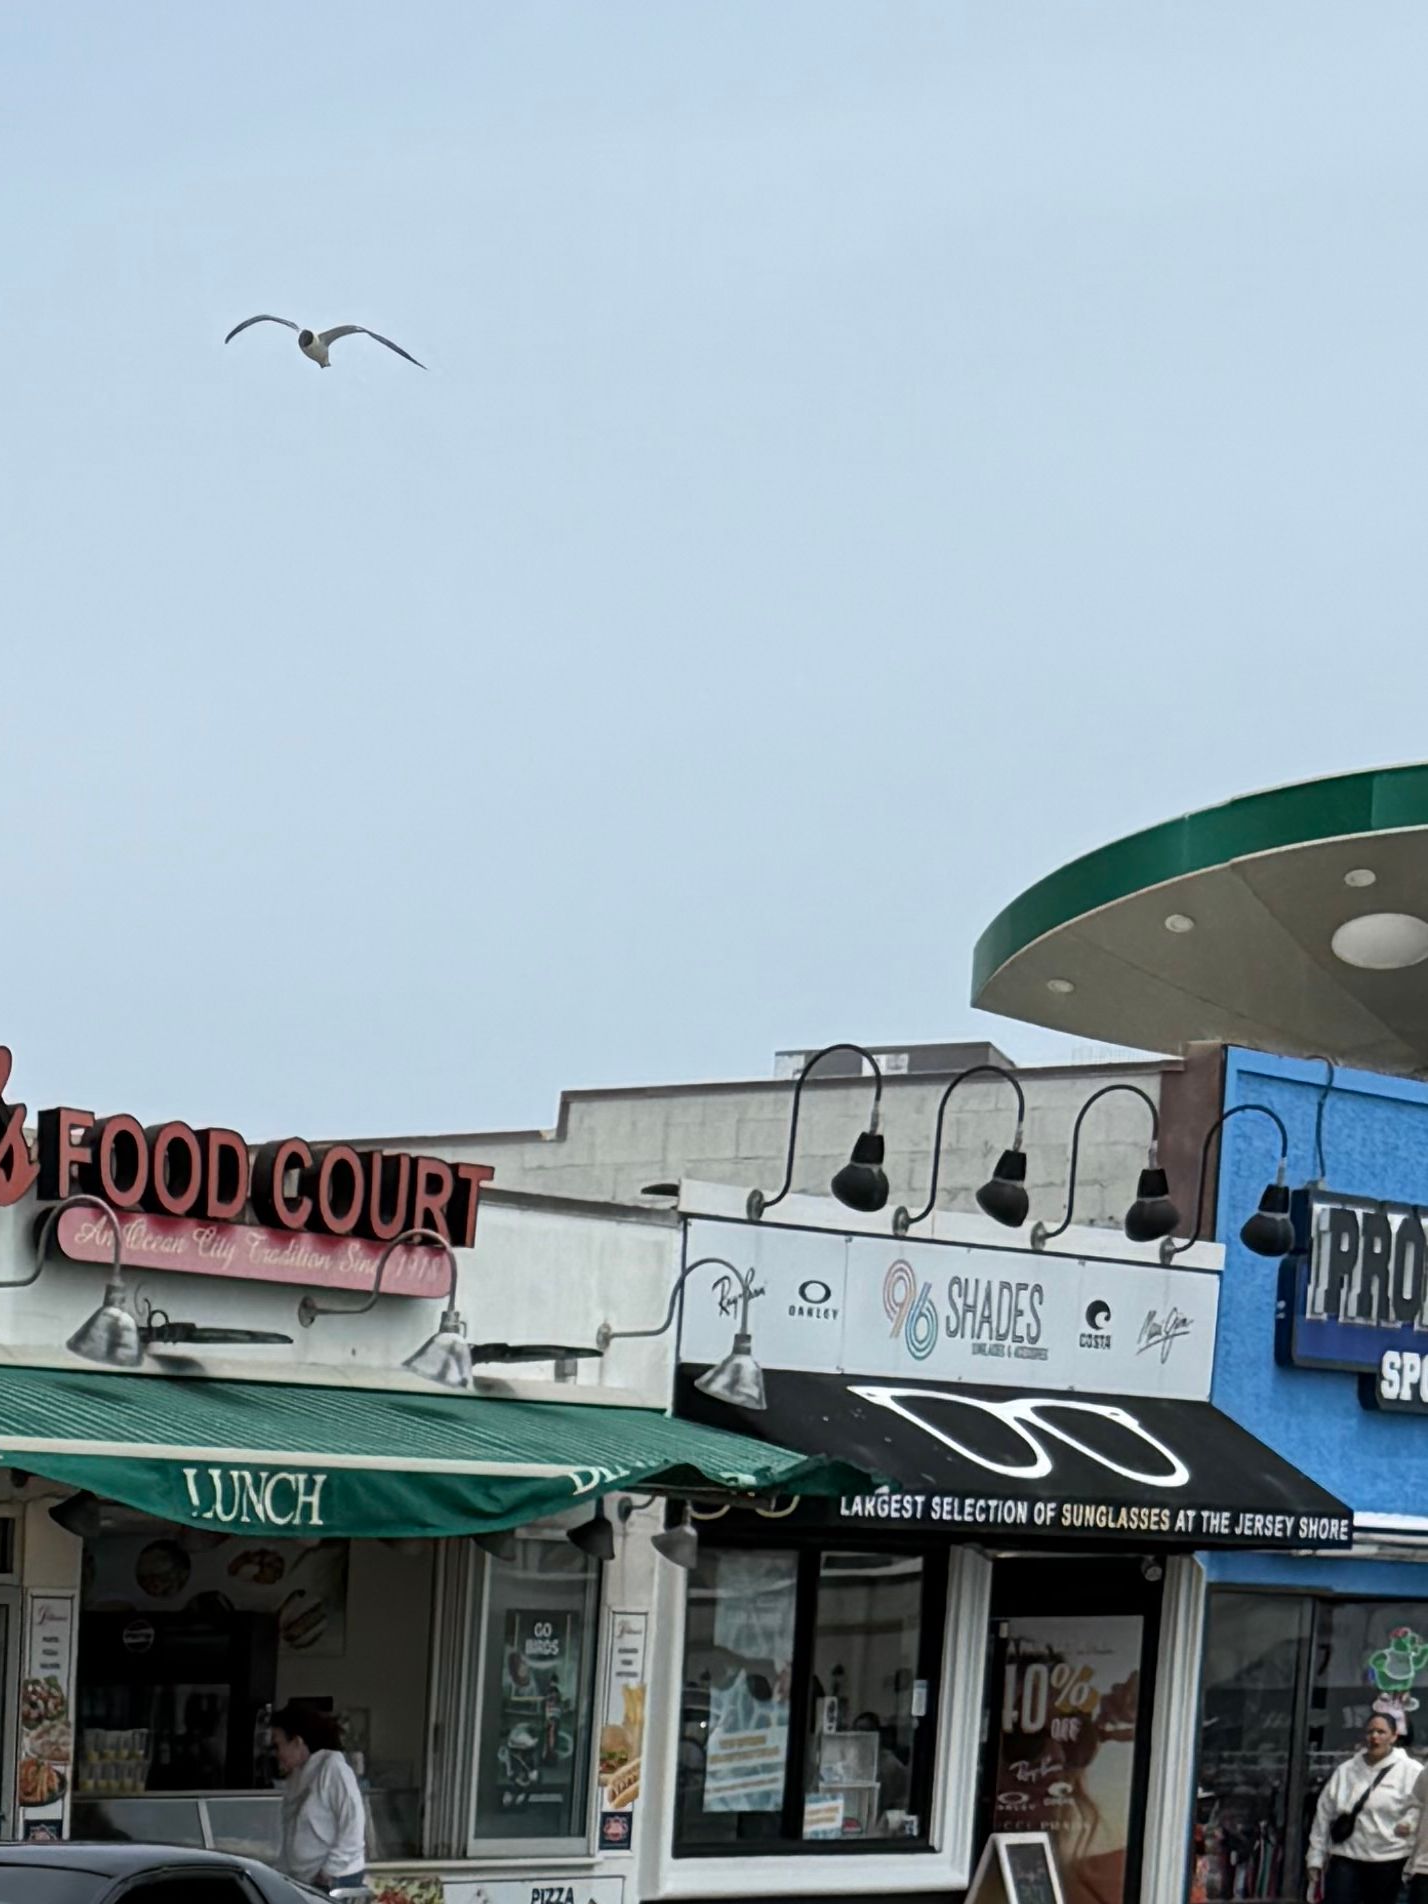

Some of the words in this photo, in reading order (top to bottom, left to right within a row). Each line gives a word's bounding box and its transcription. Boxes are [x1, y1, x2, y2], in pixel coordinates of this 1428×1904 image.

[52, 1106, 252, 1222] FOOD
[262, 1134, 496, 1250] COURT
[192, 1226, 238, 1272] City
[244, 1230, 332, 1272] Tradition
[787, 1304, 840, 1321] OAKLEY
[882, 1258, 939, 1361] 96
[945, 1275, 1044, 1346] SHADES
[1079, 1332, 1112, 1350] COSTA
[182, 1468, 328, 1526] LUNCH
[840, 1495, 925, 1519] LARGEST
[930, 1496, 1027, 1524] SELECTION
[1033, 1501, 1056, 1526] OF
[1061, 1503, 1170, 1532] SUNGLASSES
[1174, 1509, 1197, 1533] AT
[1200, 1510, 1231, 1535] THE
[1234, 1512, 1295, 1539] JERSEY
[1299, 1516, 1349, 1541] SHORE
[534, 1621, 554, 1638] GO
